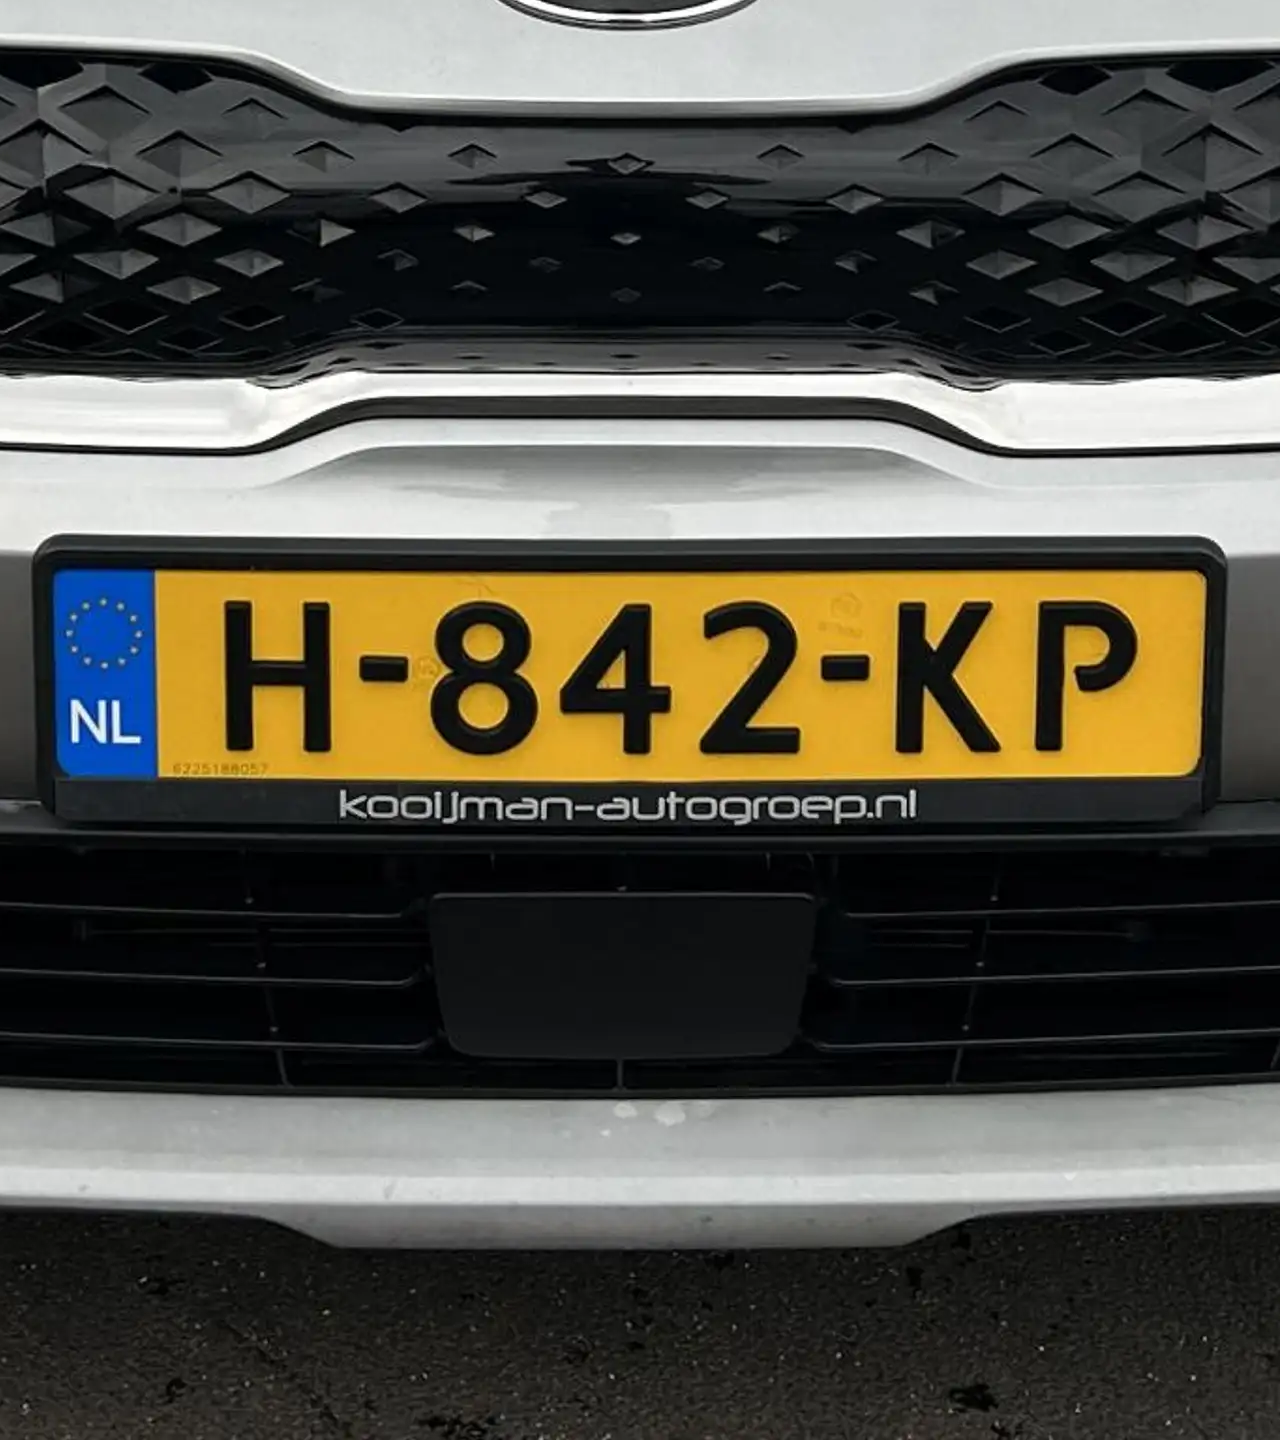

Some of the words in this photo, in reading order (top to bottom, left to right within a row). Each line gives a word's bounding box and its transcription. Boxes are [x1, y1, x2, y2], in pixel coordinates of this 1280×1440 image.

[223, 600, 1139, 755] H-842-KP
[70, 699, 142, 744] NL
[339, 789, 918, 825] kooijman-autogroep.nl
